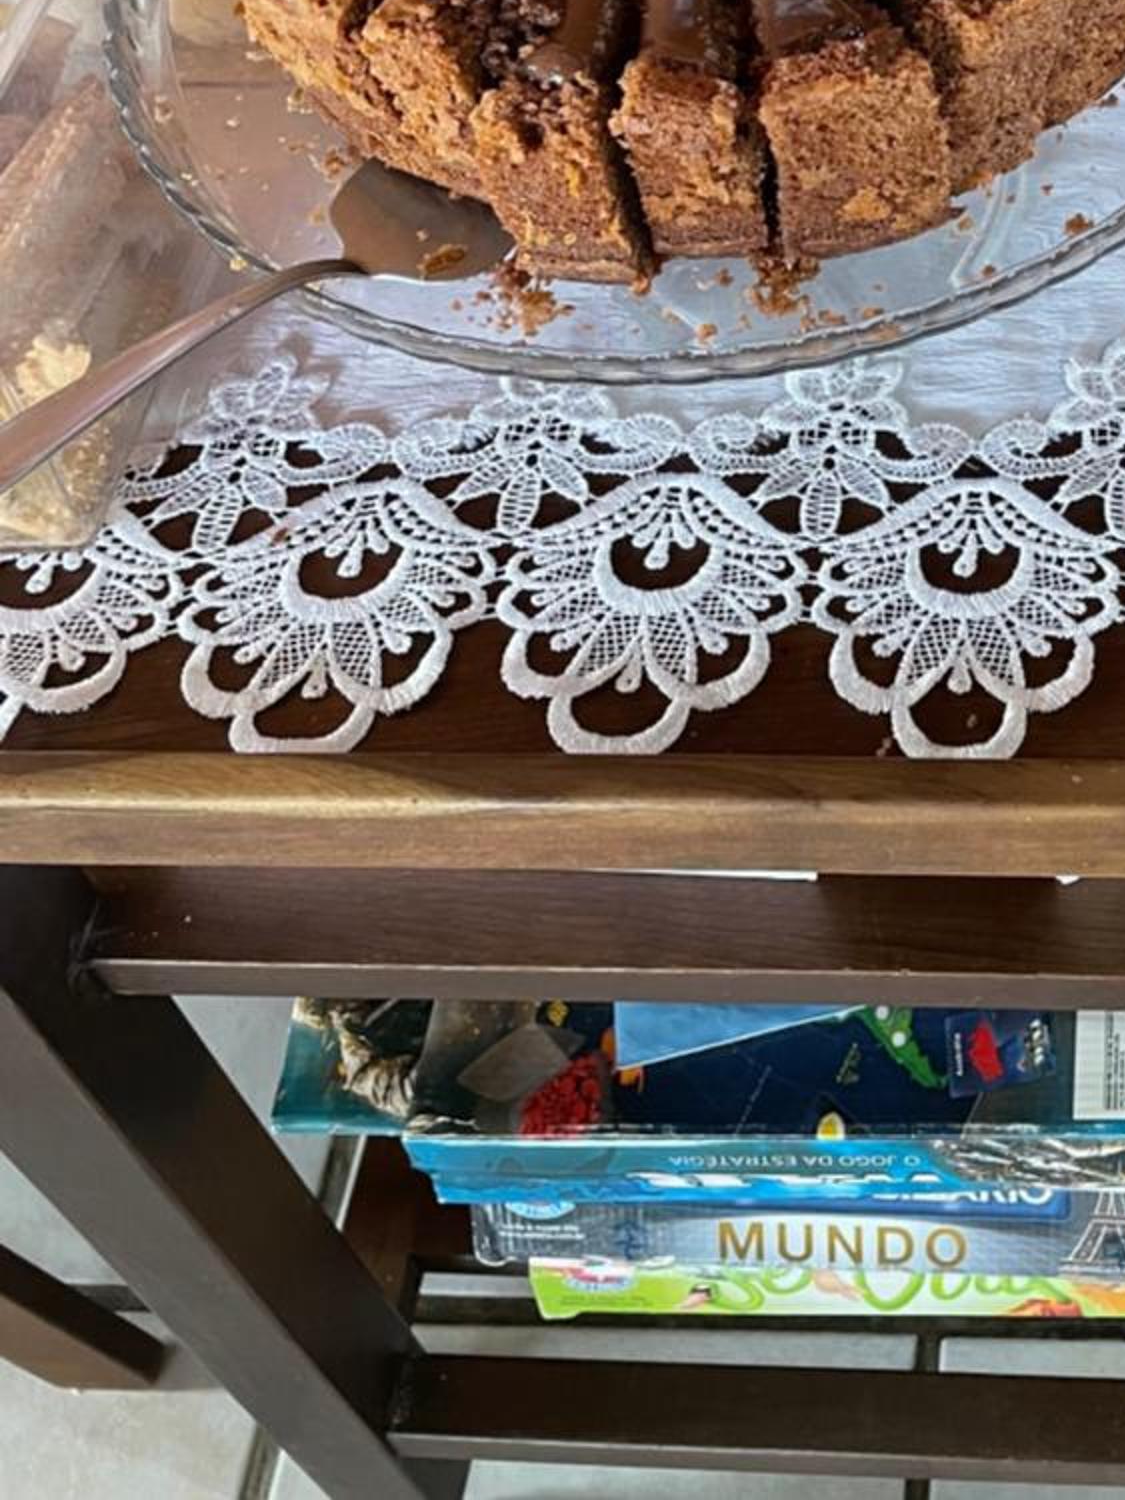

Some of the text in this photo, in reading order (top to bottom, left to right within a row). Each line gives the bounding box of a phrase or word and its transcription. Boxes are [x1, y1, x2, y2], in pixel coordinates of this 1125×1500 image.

[804, 1155, 833, 1168] DA
[840, 1155, 898, 1168] JOGO
[718, 1220, 967, 1269] MUNDO
